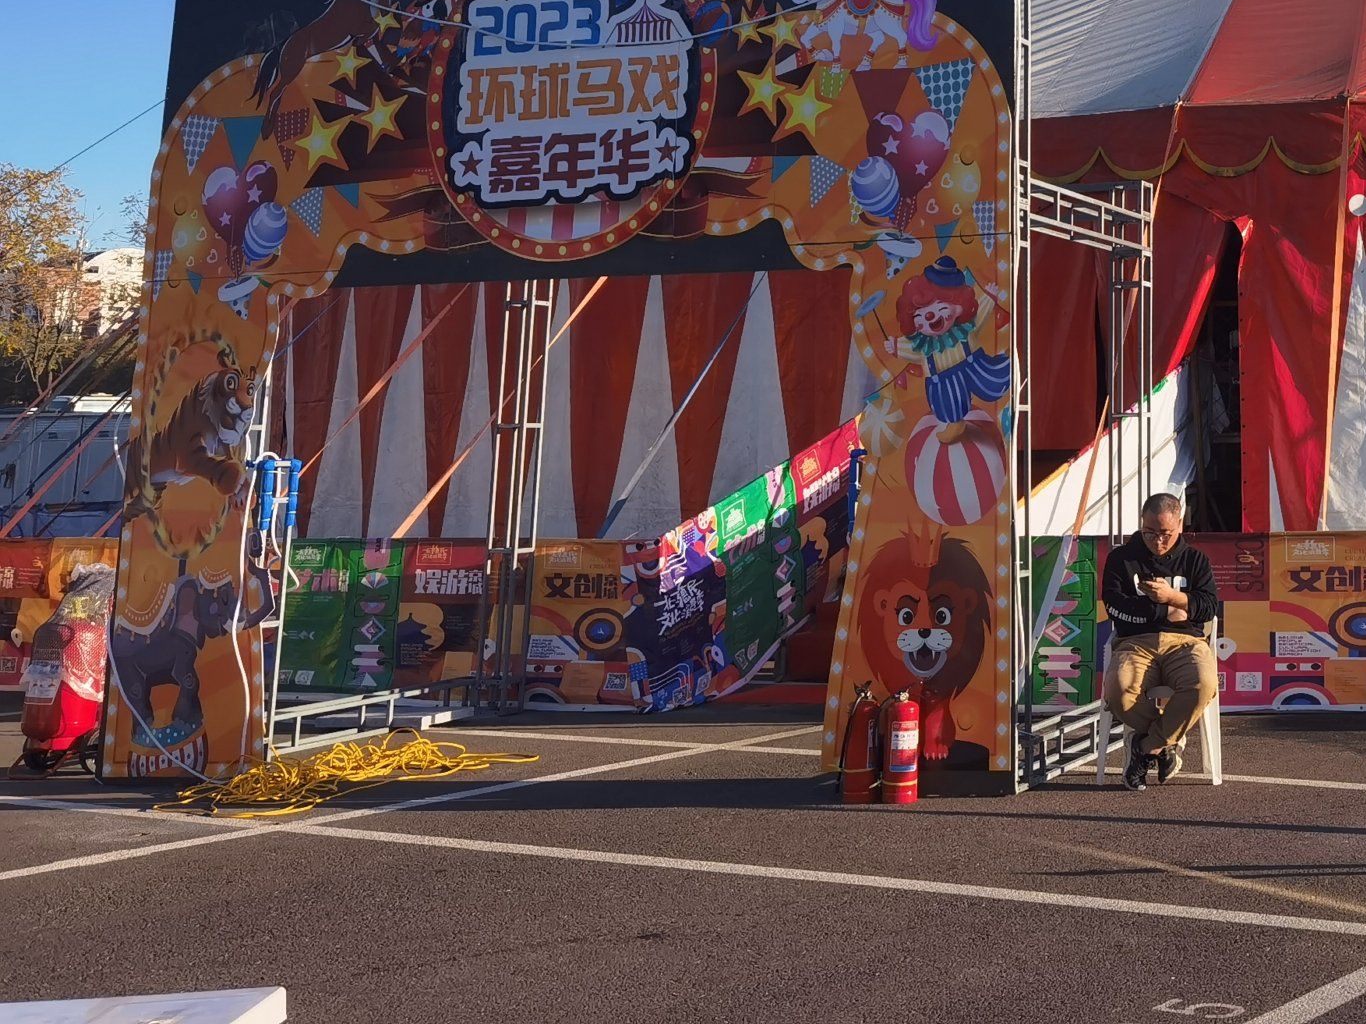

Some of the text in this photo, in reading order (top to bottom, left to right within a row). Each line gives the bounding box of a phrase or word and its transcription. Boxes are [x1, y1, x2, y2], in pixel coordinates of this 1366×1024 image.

[464, 54, 680, 125] 环球马戏
[488, 128, 650, 193] 嘉年华
